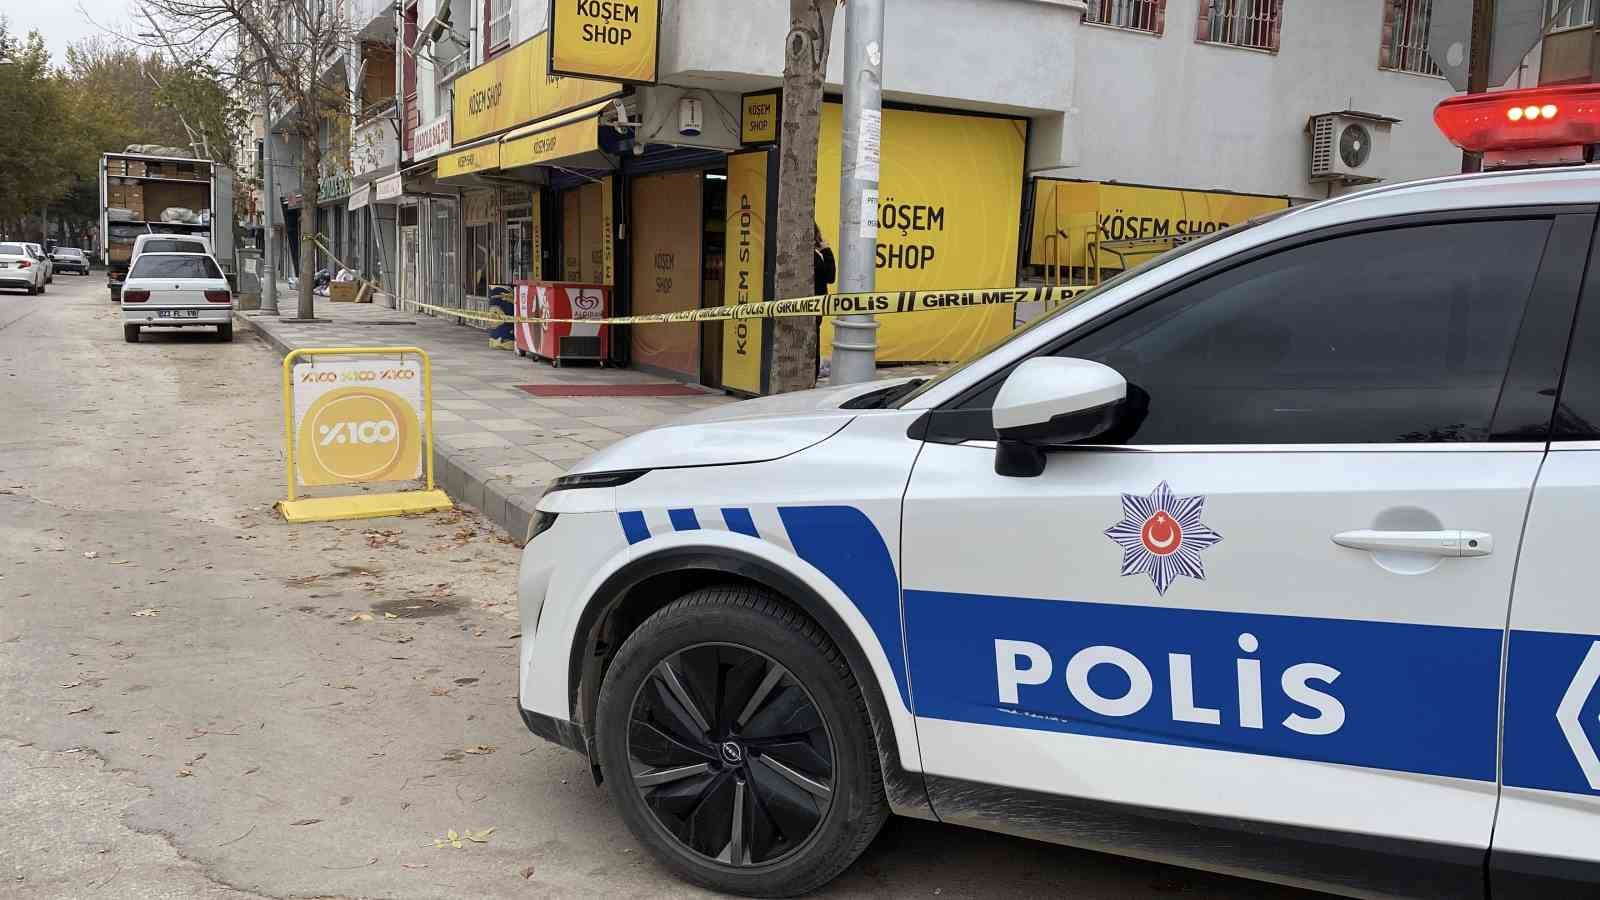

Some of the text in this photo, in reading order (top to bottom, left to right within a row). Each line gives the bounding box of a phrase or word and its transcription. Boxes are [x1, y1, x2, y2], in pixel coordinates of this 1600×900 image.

[582, 24, 632, 45] SHOP
[487, 79, 503, 109] SHOP
[749, 120, 768, 131] SHOP
[740, 194, 751, 263] SHOP
[875, 244, 935, 269] SHOP
[833, 295, 889, 312] POLİS
[922, 290, 1029, 308] GİRİLMEZ
[319, 420, 396, 446] %100
[994, 632, 1346, 736] POLİS
